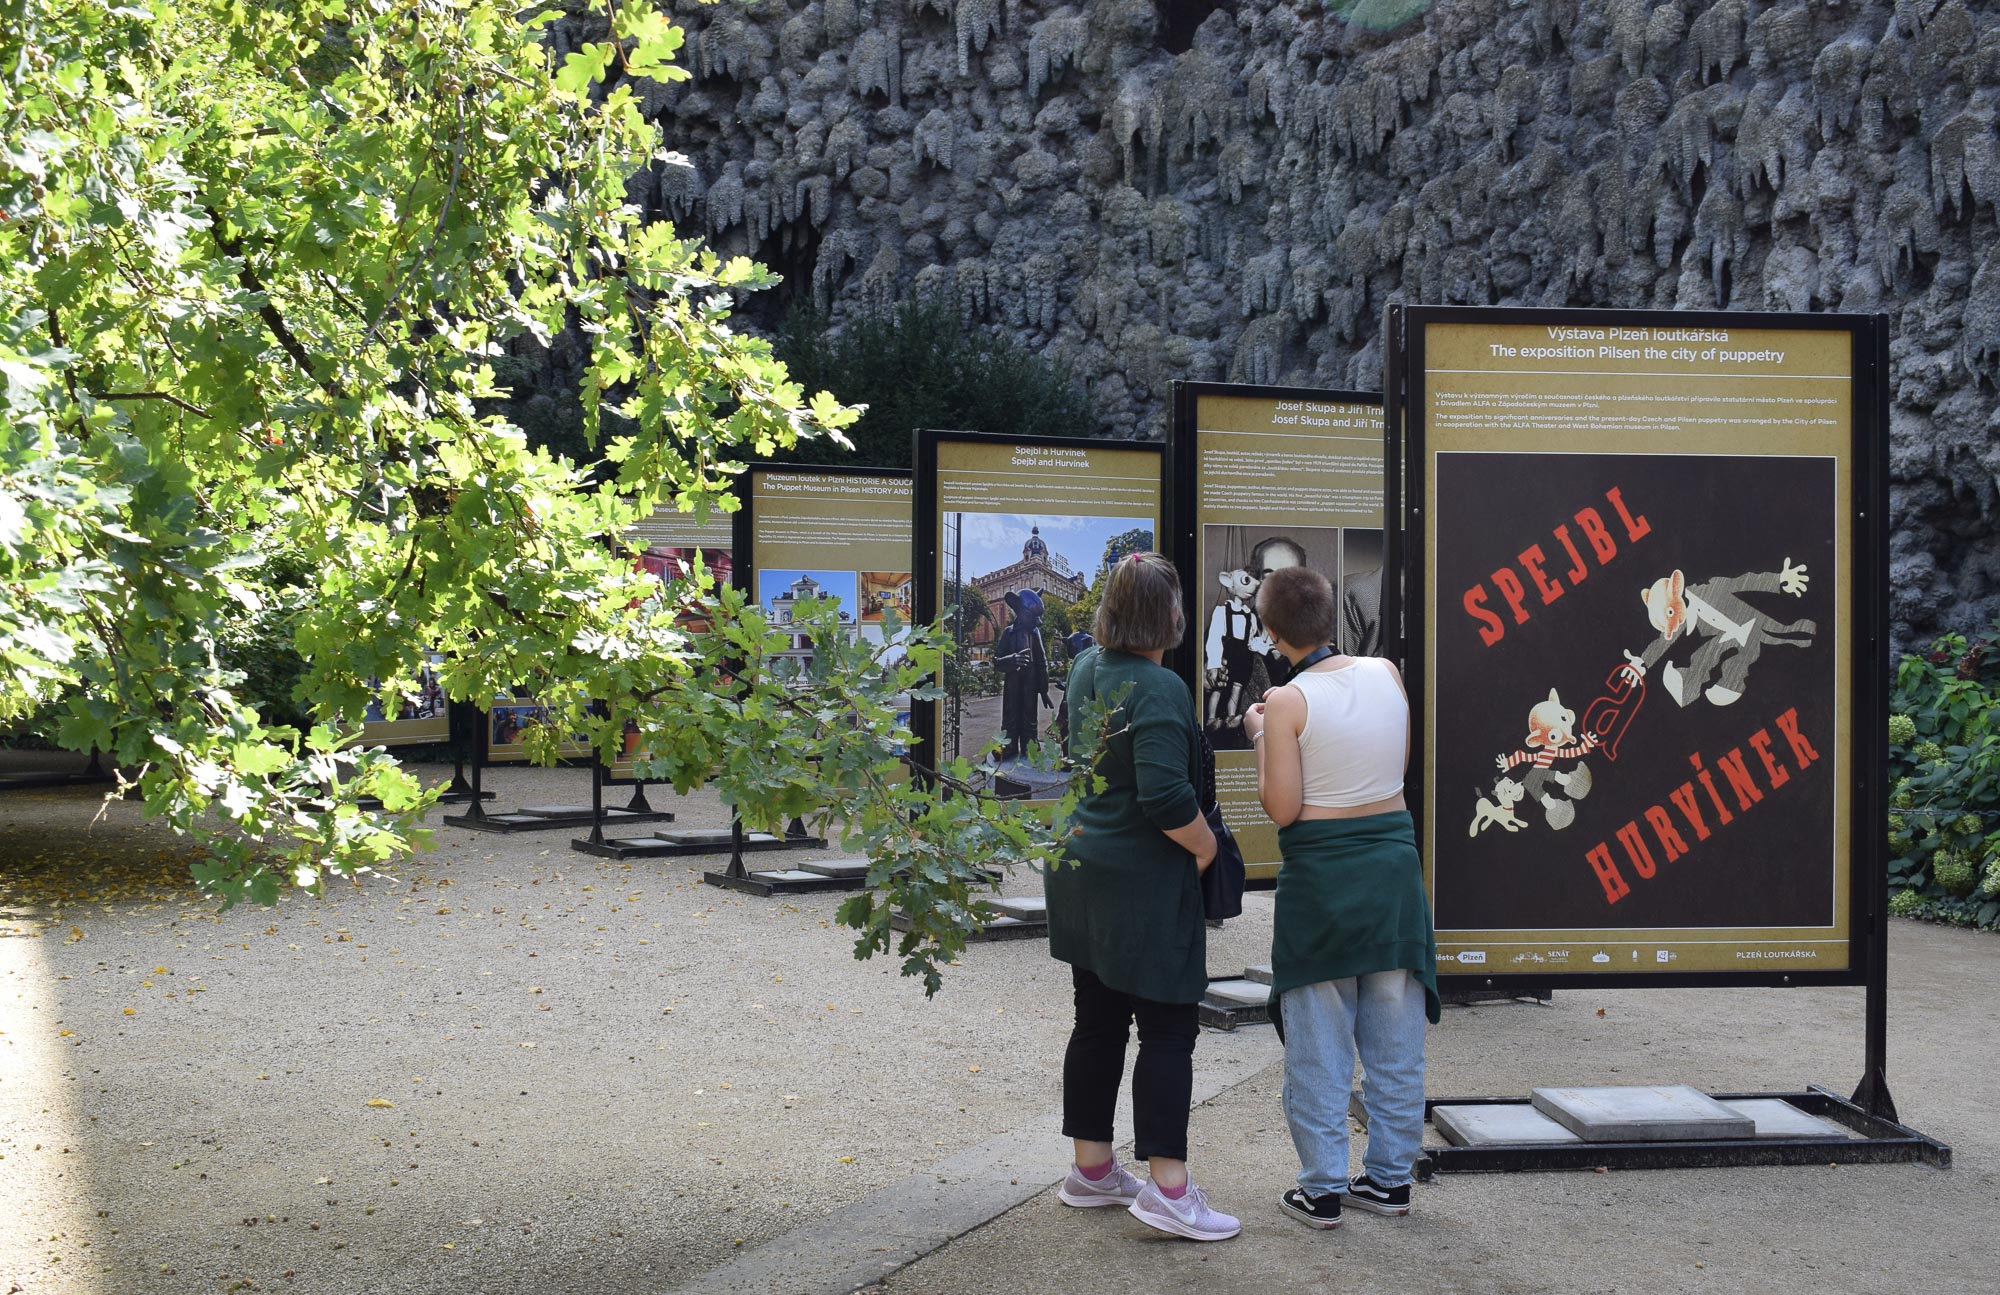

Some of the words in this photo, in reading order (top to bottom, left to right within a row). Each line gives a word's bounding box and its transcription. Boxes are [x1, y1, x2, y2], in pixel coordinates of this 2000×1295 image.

[1547, 326, 1605, 341] Výstava
[1610, 328, 1648, 340] Plzeň
[1654, 328, 1729, 342] loutkářská
[1490, 344, 1516, 357] The
[1520, 345, 1595, 359] exposition
[1599, 346, 1640, 358] Pilsen
[1644, 347, 1667, 359] the
[1671, 347, 1697, 362] city
[1701, 348, 1716, 360] of
[1719, 350, 1785, 363] puppetry
[1275, 401, 1303, 411] Josef
[1305, 402, 1336, 414] Skupa
[1338, 406, 1344, 414] a
[1347, 404, 1363, 414] Jiří
[1271, 414, 1298, 424] Josef
[1300, 416, 1330, 427] Skupa
[1332, 418, 1350, 427] and
[1353, 418, 1368, 428] Jiří
[1443, 421, 1483, 429] cooperation
[1449, 413, 1483, 422] exposition
[1601, 415, 1641, 424] present-day
[1698, 417, 1727, 425] puppetry
[1742, 417, 1772, 425] arranged
[1794, 418, 1809, 426] City
[1015, 446, 1041, 456] Spejbl
[1050, 448, 1086, 457] Hurvínek
[1011, 457, 1037, 466] Spejbl
[1055, 459, 1090, 468] Hurvínek
[798, 474, 820, 483] loutek
[828, 476, 845, 484] Plzni
[846, 477, 880, 485] HISTORIE
[777, 484, 802, 492] Puppet
[1462, 486, 1652, 647] SPEJBL
[1584, 707, 1819, 905] HURVÍNEK
[1736, 950, 1762, 958] PLZEŇ
[1764, 949, 1817, 958] LOUTKÁŘSKÁ
